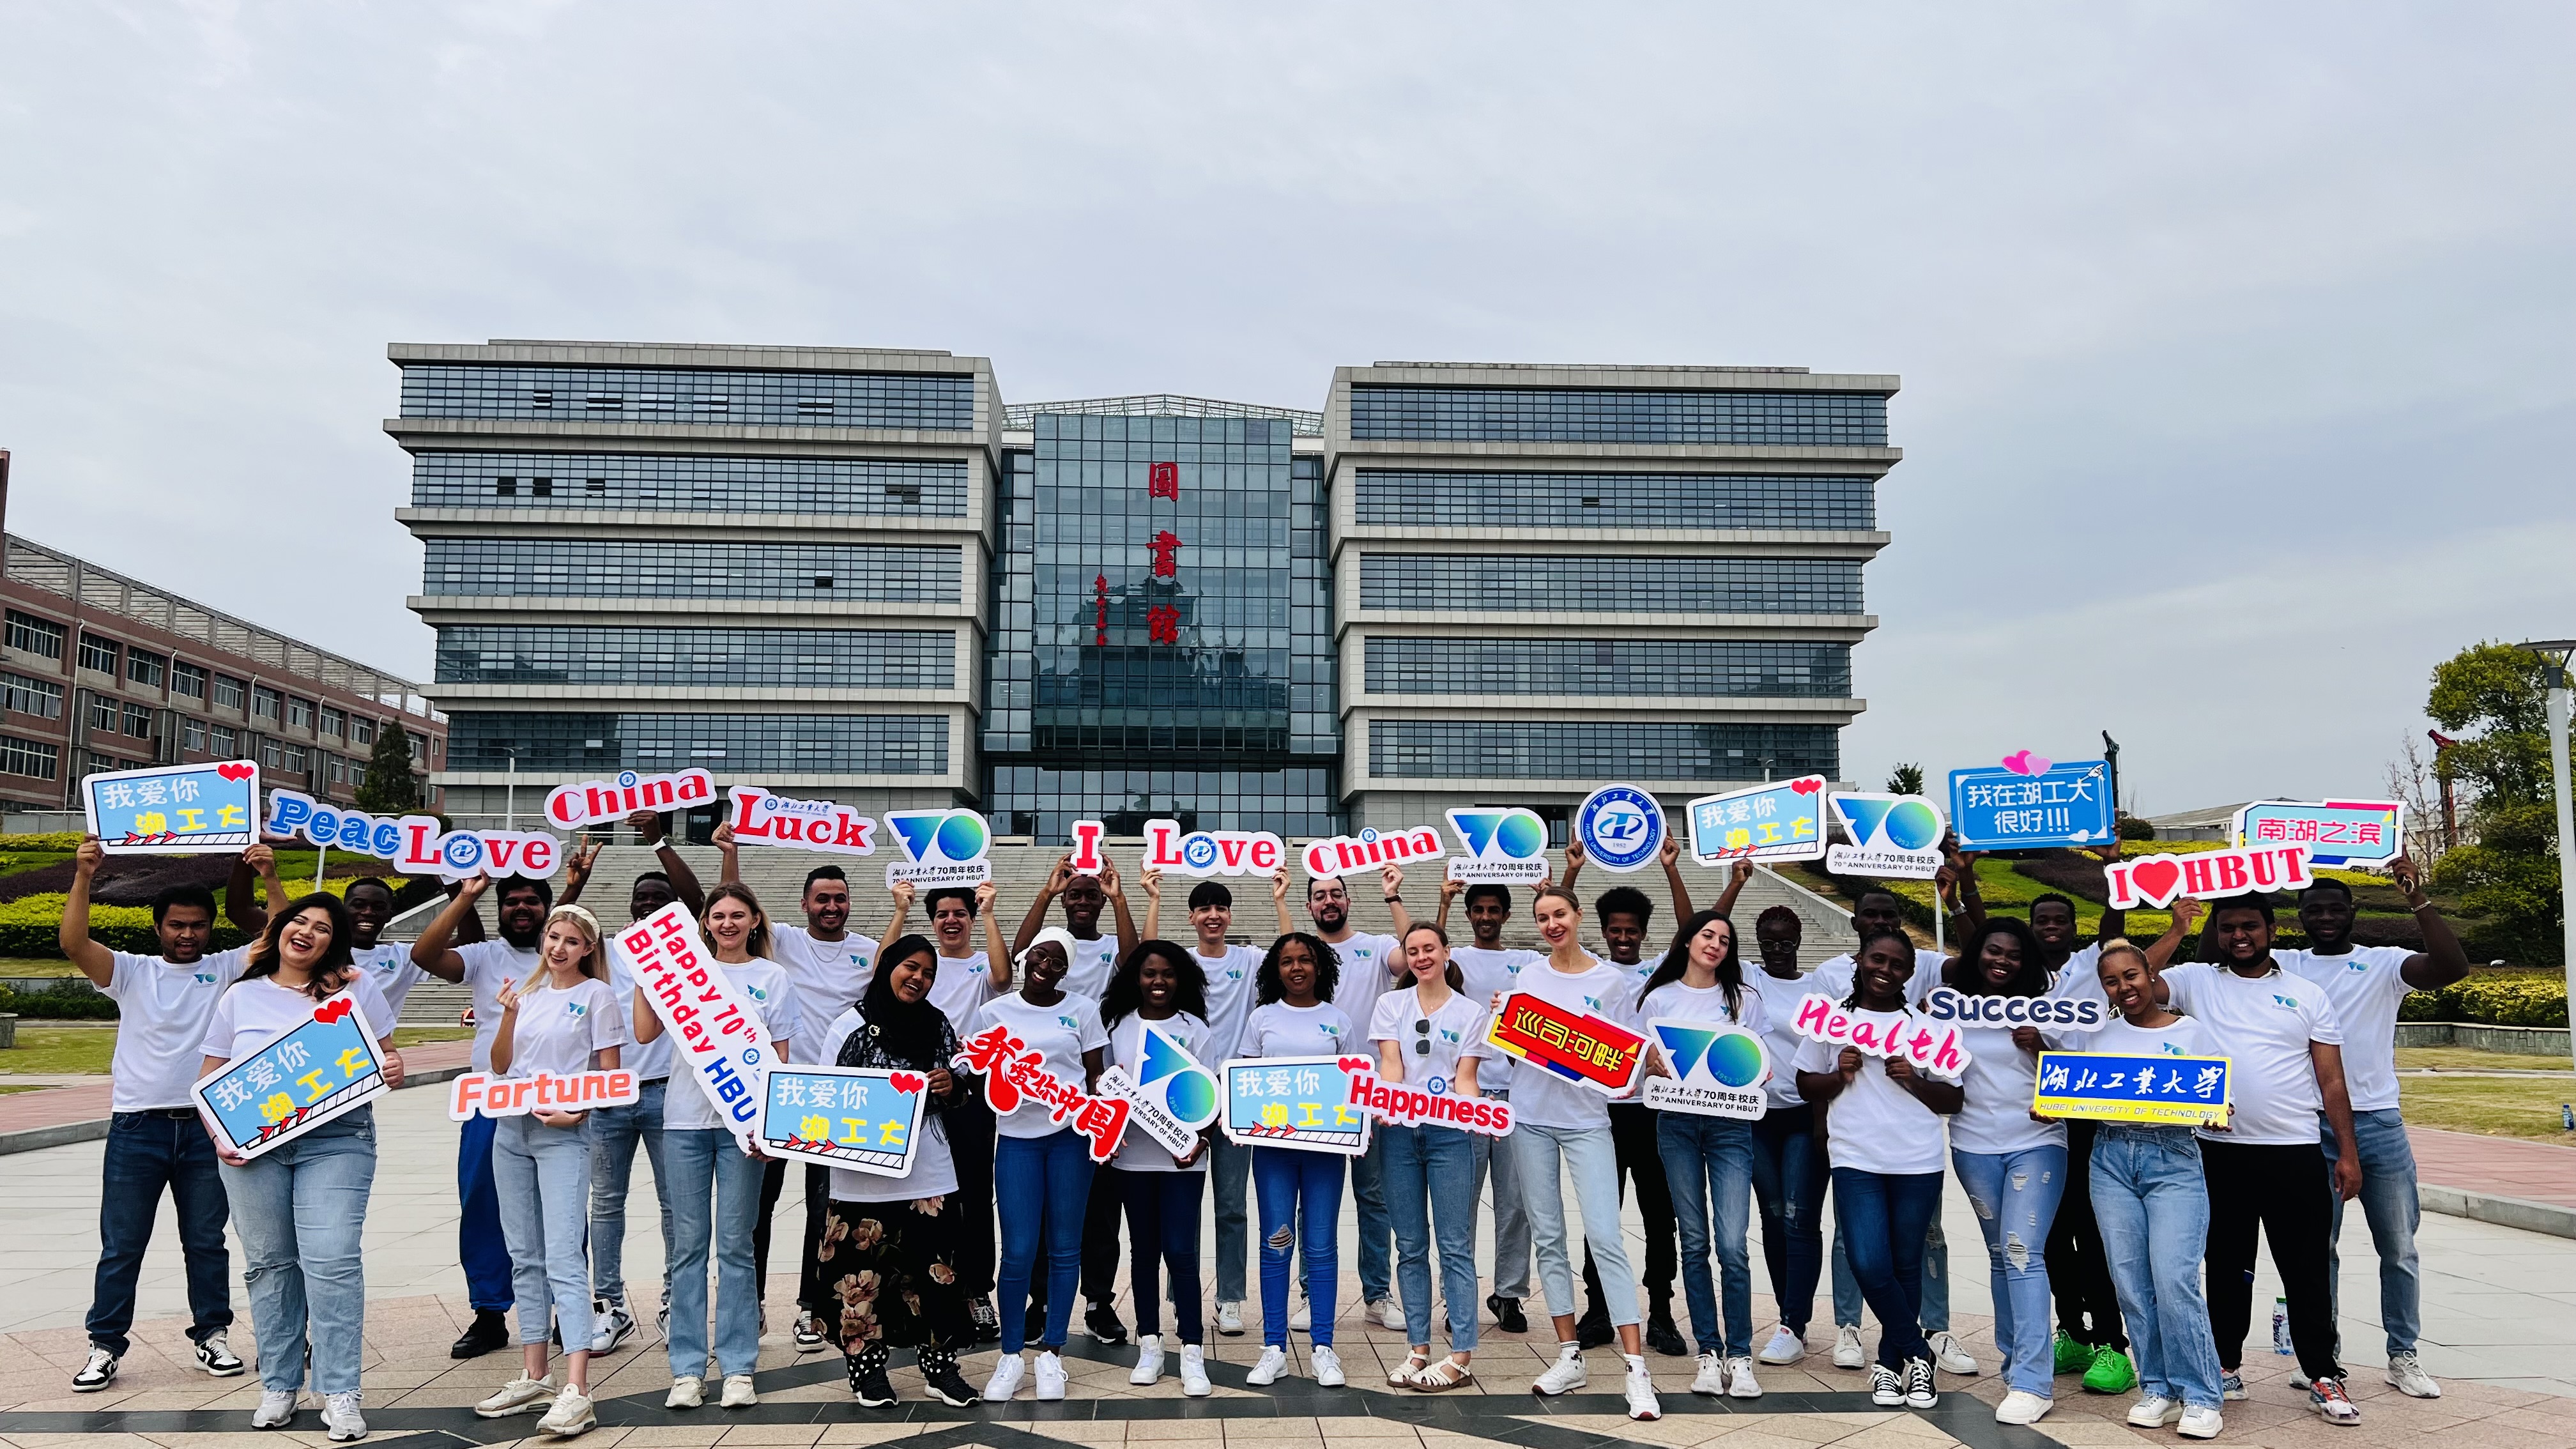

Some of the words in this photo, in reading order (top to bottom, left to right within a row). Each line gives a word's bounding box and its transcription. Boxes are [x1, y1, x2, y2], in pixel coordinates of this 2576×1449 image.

[103, 777, 200, 809] 我爱你
[553, 773, 708, 822] China
[1968, 779, 2094, 808] 我在湖工大
[135, 804, 246, 835] 湖工大
[270, 797, 401, 855] Peac
[735, 793, 868, 848] Luck
[1701, 795, 1777, 829] 我爱你
[1077, 825, 1098, 868] I
[1590, 841, 1621, 862] UNIVERSITY
[1632, 827, 1657, 860] TECHNOLOGY
[1725, 816, 1815, 849] 湖工大
[2257, 817, 2382, 847] 南湖之滨
[1309, 830, 1438, 873] China
[1848, 862, 1903, 870] ANNIVERSARY
[2112, 869, 2131, 902] I
[2181, 847, 2304, 894] HBUT
[652, 912, 722, 1002] Happy
[714, 1003, 758, 1044] 70th
[1931, 990, 2099, 1024] Success
[624, 929, 716, 1054] Birthday
[703, 1056, 757, 1123] HBU
[1512, 1006, 1626, 1073] 巡司河畔
[1798, 999, 1963, 1071] Health
[213, 1041, 311, 1111] 我爱你
[259, 1046, 370, 1124] 湖工大
[457, 1073, 630, 1113] Fortune
[1237, 1069, 1321, 1098] 我爱你
[776, 1077, 869, 1110] 我爱你
[1349, 1075, 1510, 1131] Happiness
[1665, 1097, 1724, 1109] ANNIVERSARY
[1736, 1105, 1758, 1113] HBUT
[1261, 1101, 1359, 1127] 湖工大
[2072, 1105, 2131, 1114] UNIVERSITY
[2151, 1108, 2220, 1119] TECHNOLOGY
[800, 1114, 905, 1146] 湖工大
[1159, 1128, 1169, 1136] OF
[1167, 1133, 1186, 1151] HBUT
